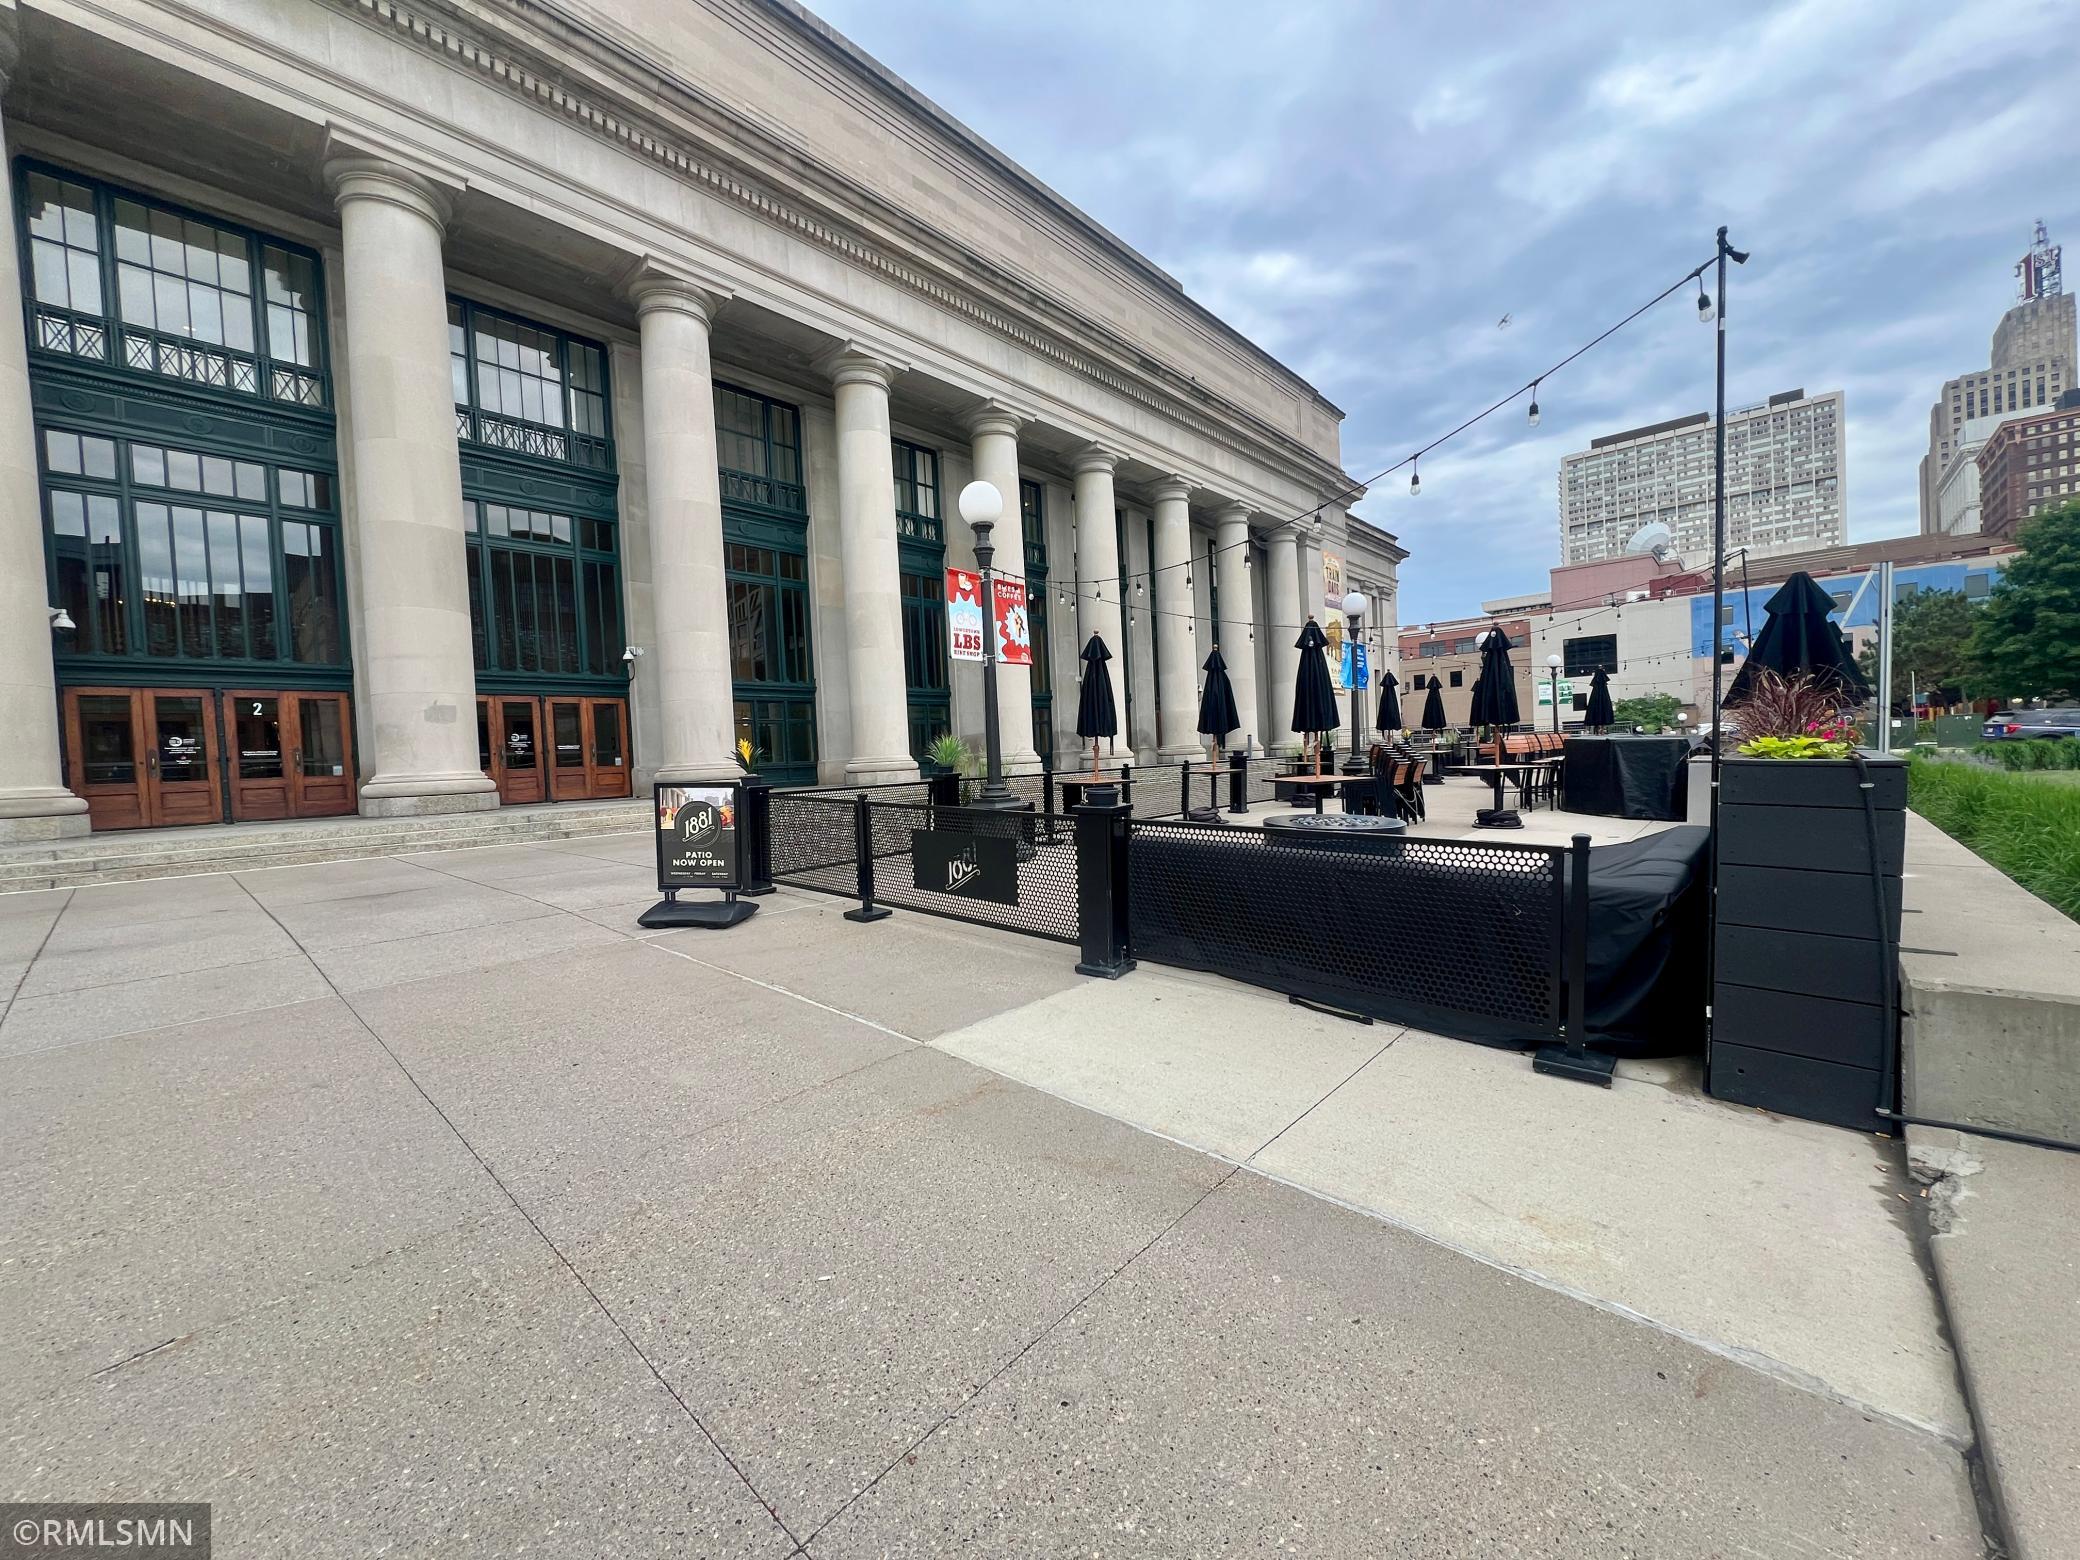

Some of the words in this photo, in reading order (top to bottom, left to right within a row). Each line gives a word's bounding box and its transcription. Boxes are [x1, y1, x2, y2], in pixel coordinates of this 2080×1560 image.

[953, 632, 981, 651] LBS
[253, 702, 263, 716] 2
[684, 806, 713, 839] 1881
[685, 851, 713, 859] PATIO
[672, 859, 697, 867] NOW
[699, 859, 725, 867] OPEN
